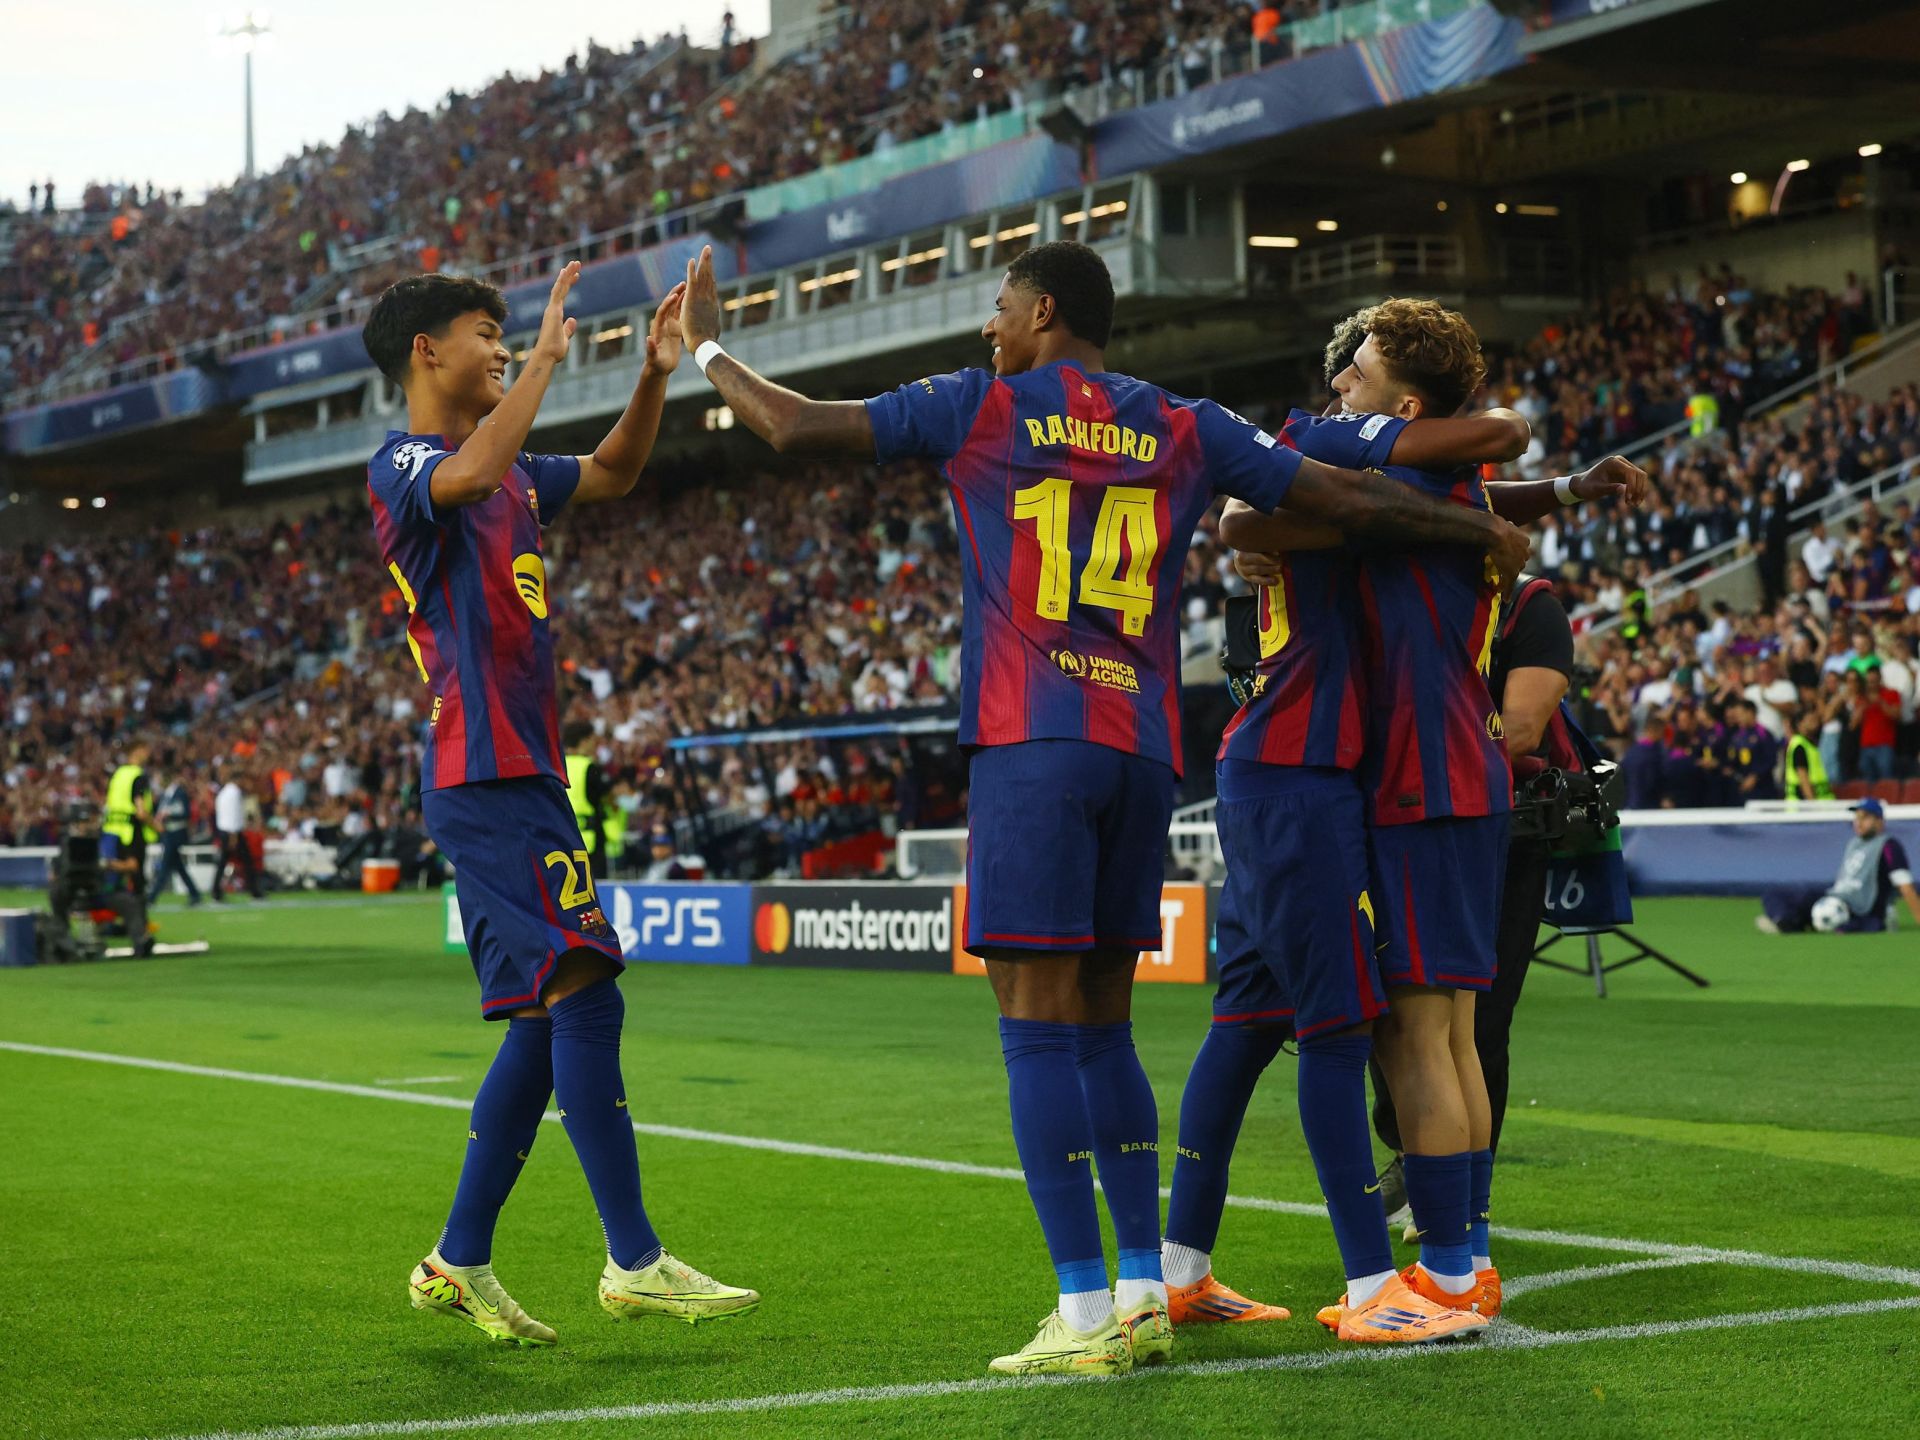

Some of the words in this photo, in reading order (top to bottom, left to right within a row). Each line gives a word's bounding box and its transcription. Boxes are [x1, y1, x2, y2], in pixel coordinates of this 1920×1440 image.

[1024, 414, 1158, 462] RASHFORD
[1014, 478, 1159, 637] 14
[1089, 655, 1136, 678] UNHCR
[1090, 668, 1139, 689] ACNUR
[642, 897, 722, 947] PS5
[794, 897, 952, 952] mastercard
